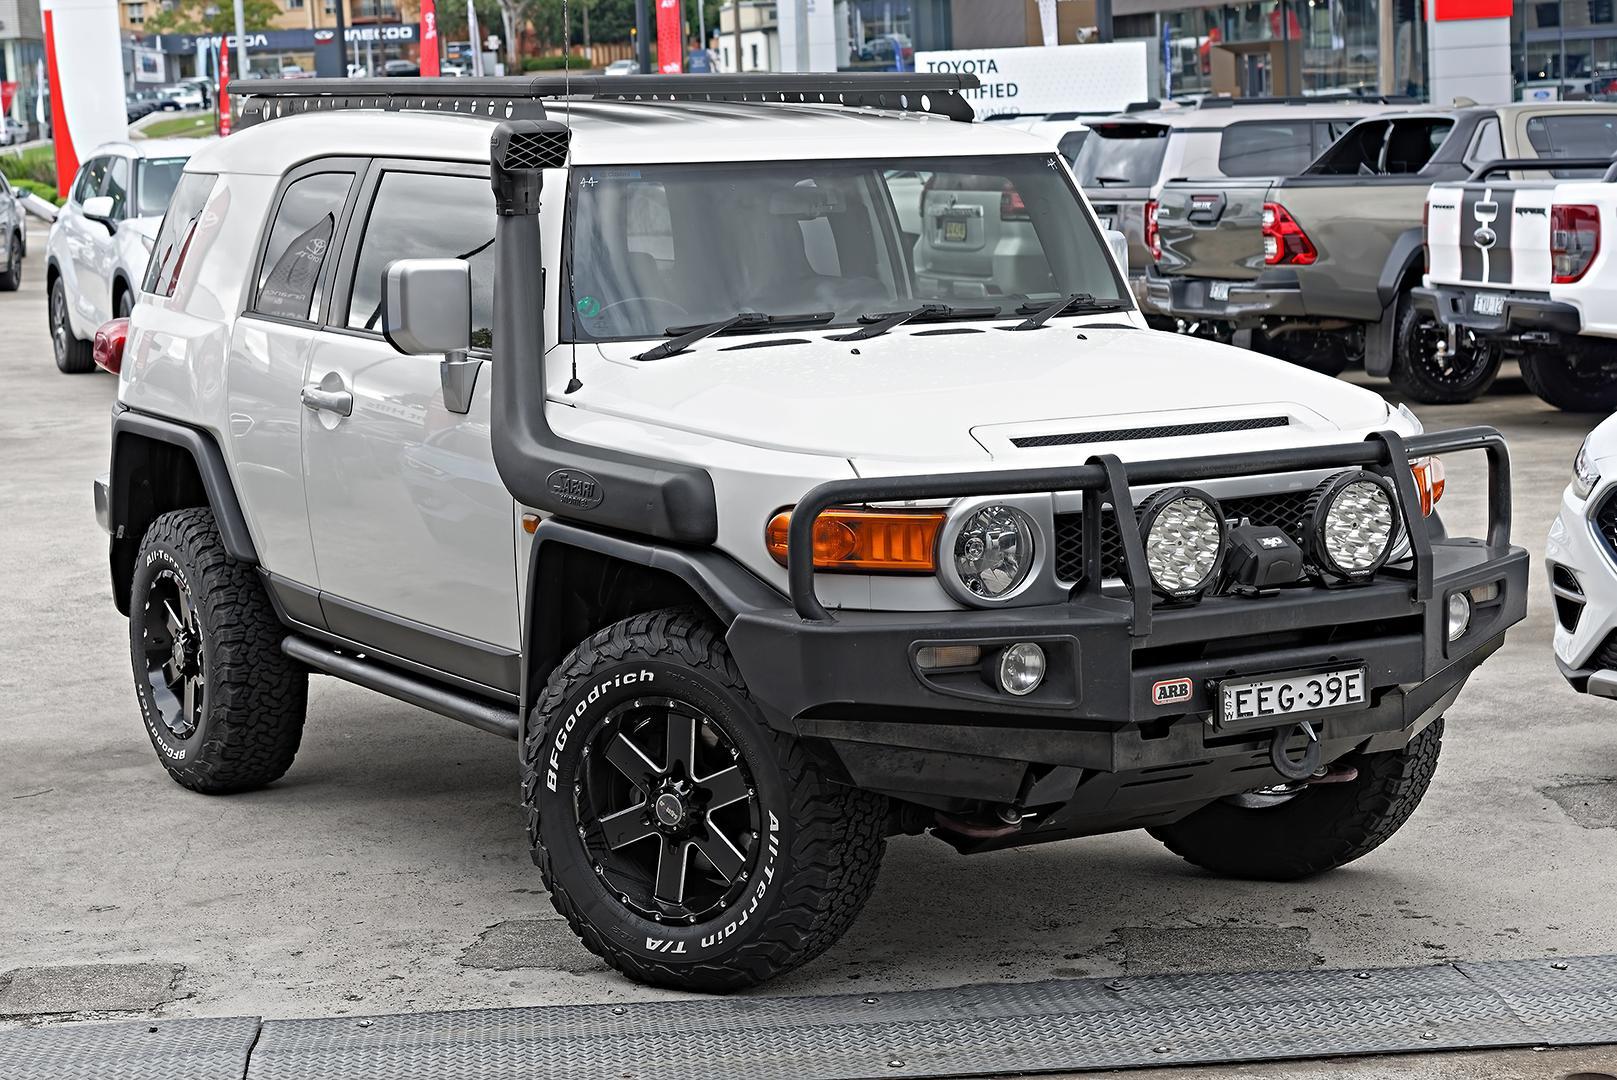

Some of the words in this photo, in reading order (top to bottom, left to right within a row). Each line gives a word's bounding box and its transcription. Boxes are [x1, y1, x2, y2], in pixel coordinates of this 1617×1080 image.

[926, 59, 999, 74] TOYOTA
[550, 472, 597, 498] SAFARI
[1157, 683, 1189, 700] ARB
[138, 683, 186, 760] BFGoodrich
[546, 669, 655, 793] BFGoodrich
[700, 809, 780, 948] All-Terrain
[645, 936, 687, 954] T/A
